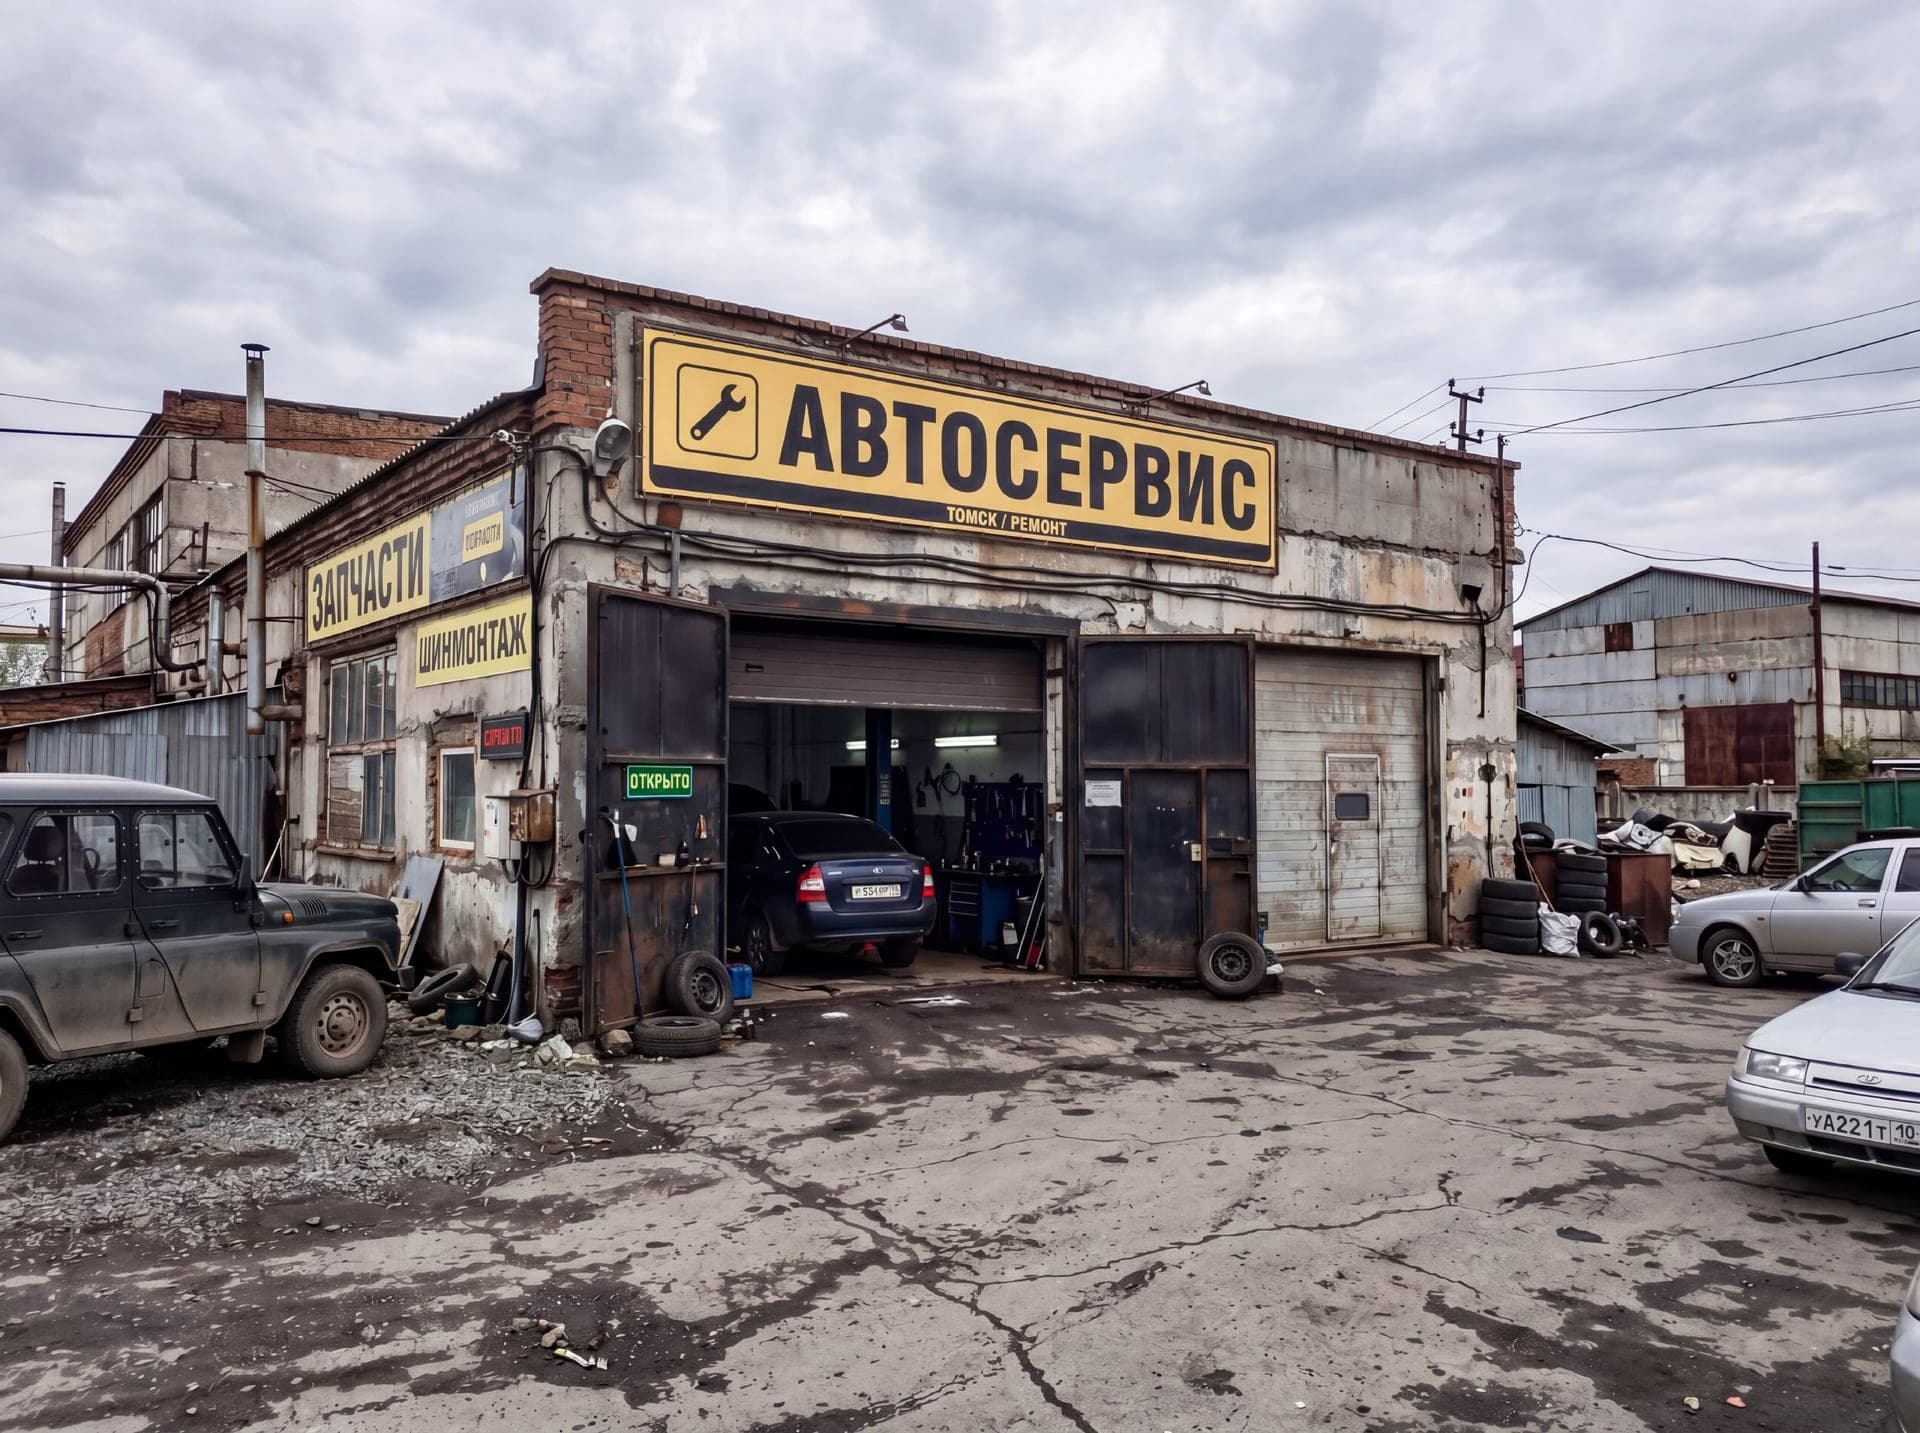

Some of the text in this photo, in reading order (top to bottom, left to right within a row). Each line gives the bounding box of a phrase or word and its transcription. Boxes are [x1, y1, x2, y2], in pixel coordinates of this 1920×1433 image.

[779, 383, 1256, 531] АВТОСЕРВИС
[947, 506, 998, 527] ТОМСК
[1010, 515, 1068, 536] РЕМОНТ
[312, 525, 424, 632] ЗАПЧАСТИ
[419, 612, 527, 674] ШИНМОНТАЖ
[629, 772, 690, 790] ОТКРЫТО
[1896, 1124, 1915, 1139] 10
